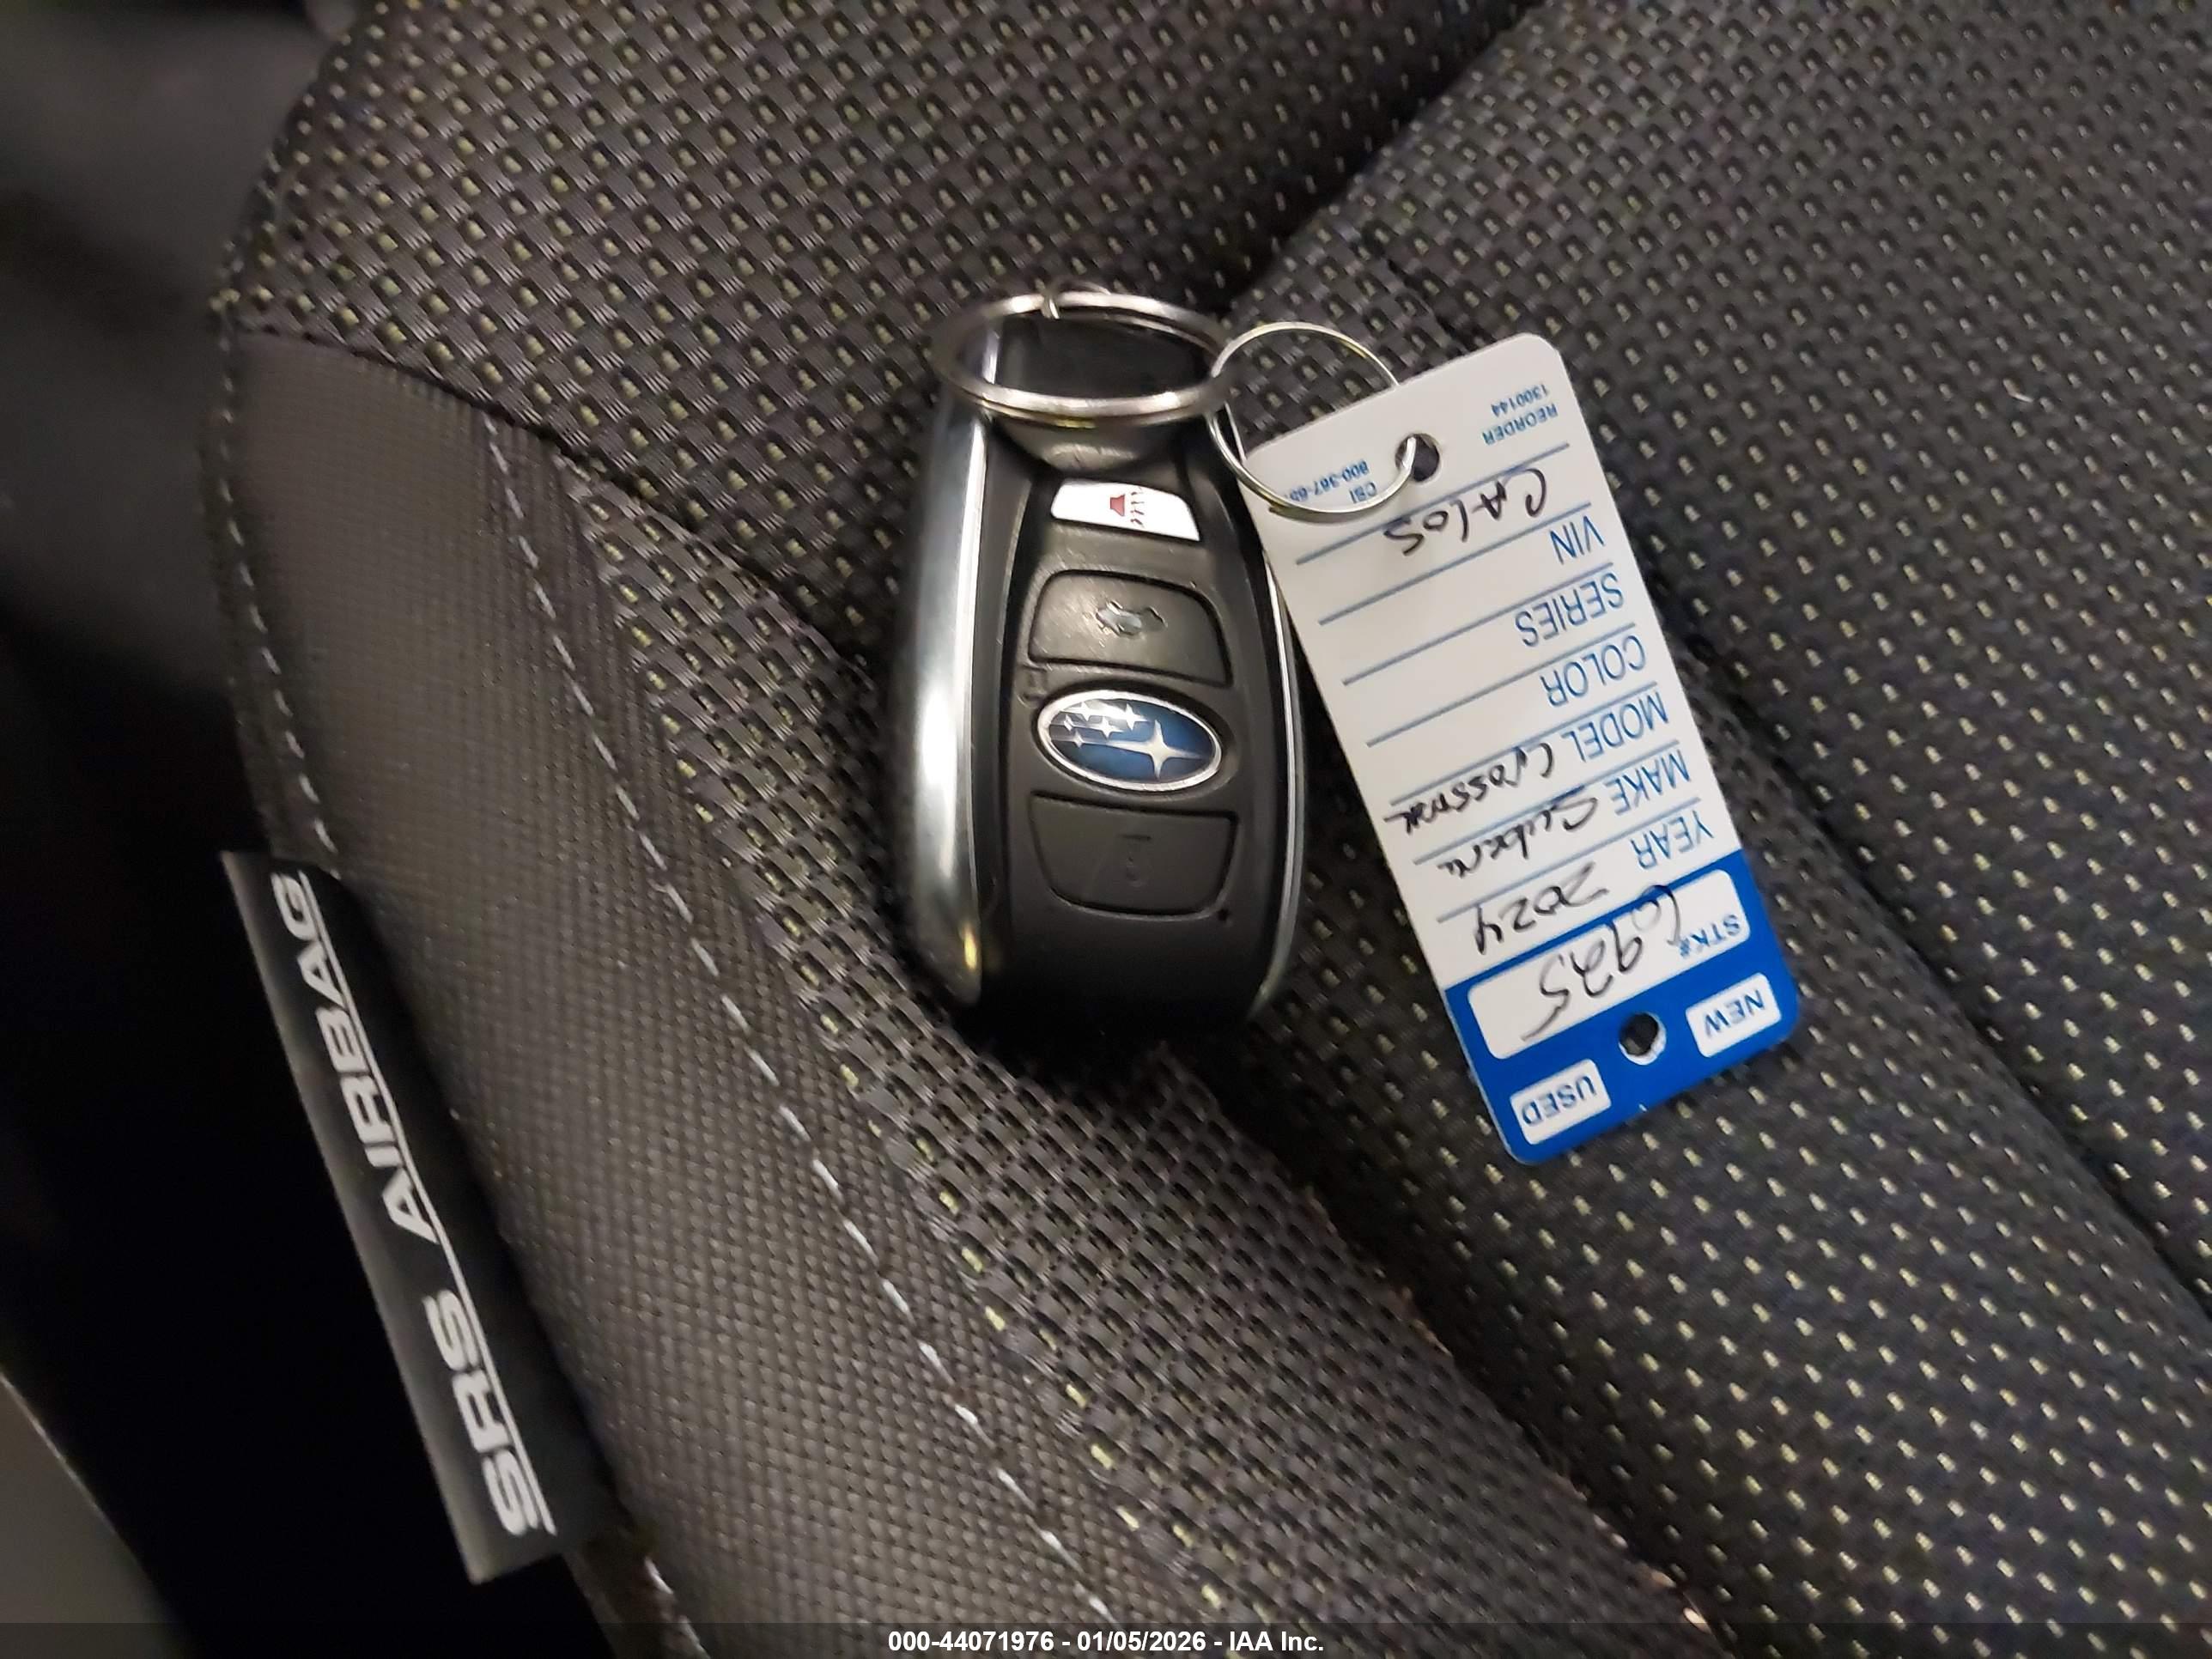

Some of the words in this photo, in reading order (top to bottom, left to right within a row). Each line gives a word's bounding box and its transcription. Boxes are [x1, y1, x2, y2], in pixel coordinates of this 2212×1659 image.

[1481, 402, 1558, 446] REORDER
[1553, 515, 1605, 565] VIN
[1515, 572, 1623, 647] SERIES
[1541, 634, 1647, 708] COLOR
[1560, 691, 1669, 761] MODEL
[1610, 750, 1690, 817] MAKE
[1631, 810, 1713, 870] YEAR
[1474, 861, 1608, 955] 2024
[1705, 990, 1765, 1038] NEW
[271, 872, 438, 1244] AIRBAG
[1522, 1075, 1597, 1126] USED
[422, 1288, 539, 1536] SRS
